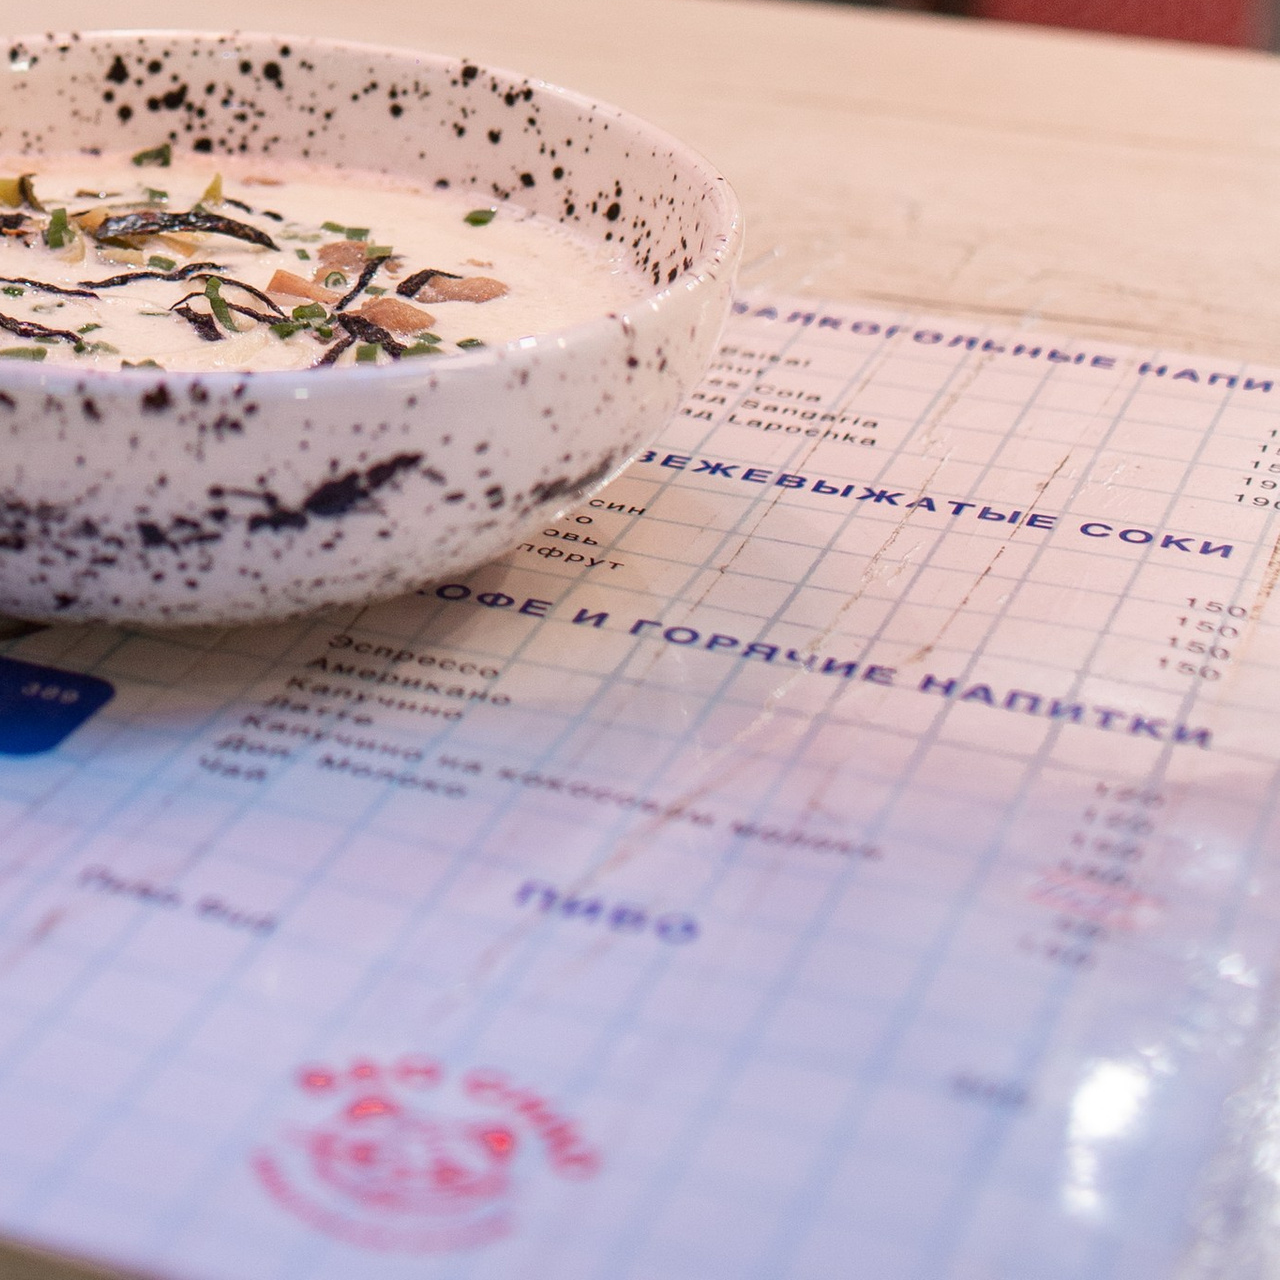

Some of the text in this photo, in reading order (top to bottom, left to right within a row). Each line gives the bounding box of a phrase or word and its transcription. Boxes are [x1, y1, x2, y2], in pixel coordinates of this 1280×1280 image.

[1137, 361, 1274, 393] НАПИ
[727, 414, 877, 447] Lapochka
[741, 399, 879, 430] Sangaria
[1078, 522, 1234, 559] СОКИ
[1186, 597, 1247, 618] 150
[1177, 616, 1238, 639] 150
[328, 634, 499, 679] Эспрессо
[1167, 636, 1230, 660] 150
[304, 657, 511, 706] Американо
[417, 583, 1214, 750] ОФЕ И ГОРЯЧИЕ НАПИТКИ
